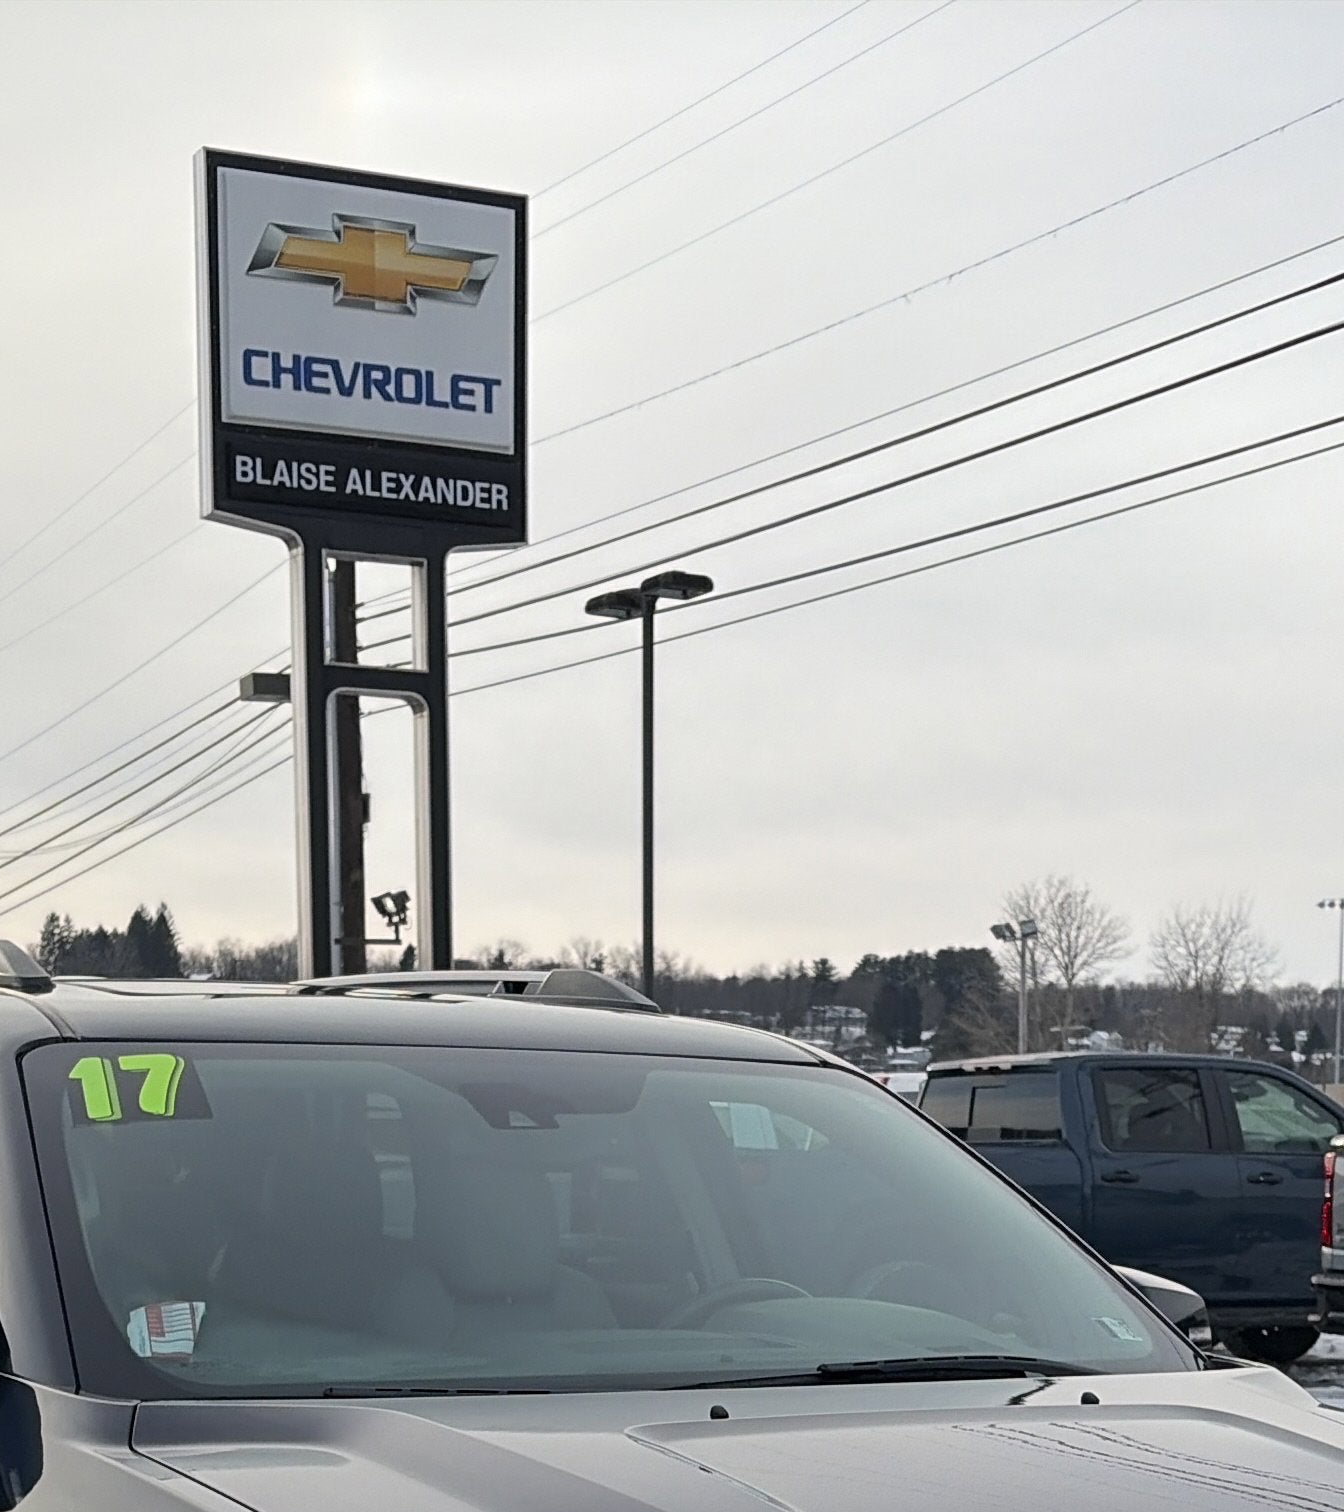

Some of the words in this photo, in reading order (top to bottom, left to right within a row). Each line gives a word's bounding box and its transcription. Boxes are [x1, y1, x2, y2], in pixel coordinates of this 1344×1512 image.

[242, 348, 502, 414] CHEVROLET
[235, 454, 337, 493] BLAISE
[345, 467, 509, 511] ALEXANDER
[68, 1053, 185, 1121] 17
